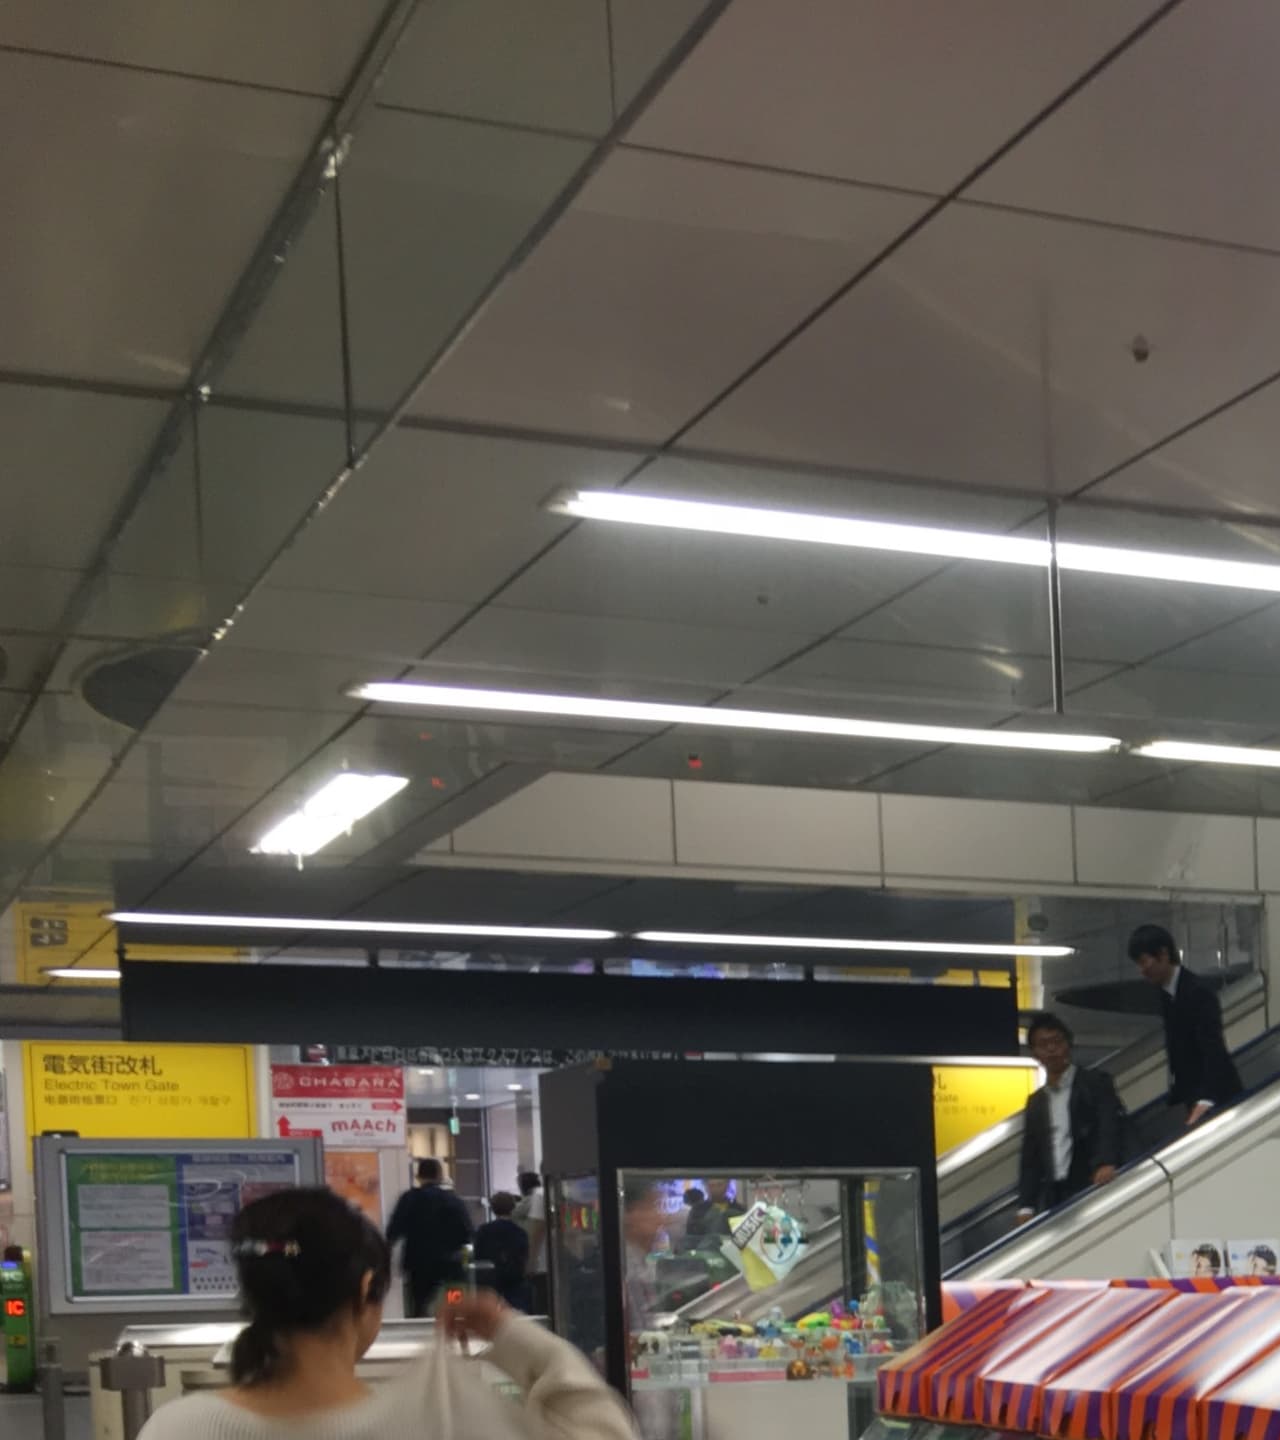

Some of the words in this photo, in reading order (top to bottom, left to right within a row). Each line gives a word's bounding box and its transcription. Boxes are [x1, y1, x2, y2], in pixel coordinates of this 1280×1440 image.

[43, 1053, 163, 1076] 電気街改札
[44, 1079, 96, 1091] Electric
[103, 1079, 140, 1091] Town
[145, 1079, 180, 1092] Gate
[331, 1119, 397, 1133] mAAch
[6, 1298, 26, 1316] IC
